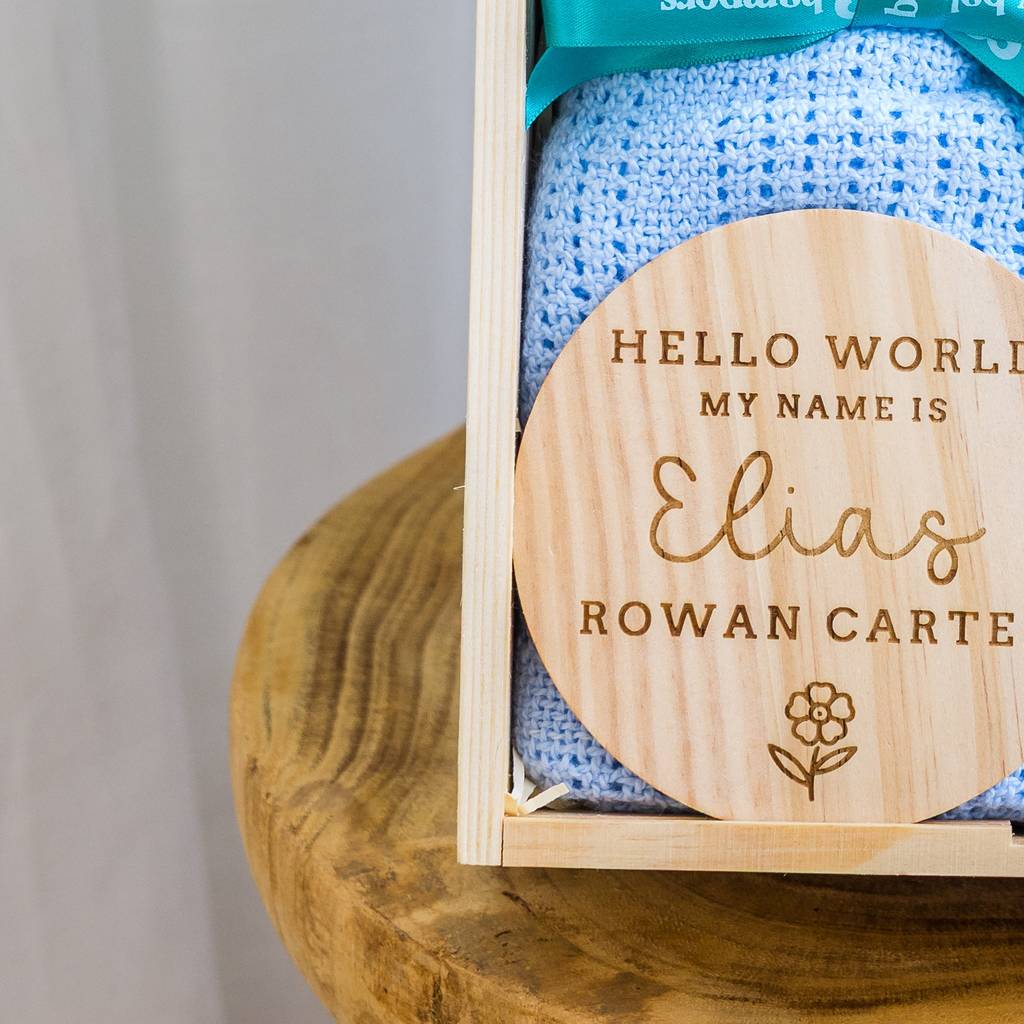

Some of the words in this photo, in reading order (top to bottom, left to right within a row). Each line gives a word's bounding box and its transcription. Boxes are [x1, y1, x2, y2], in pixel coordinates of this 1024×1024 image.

[610, 328, 800, 369] HELLO
[699, 391, 759, 418] MY
[776, 392, 894, 422] NAME
[911, 397, 948, 424] IS
[649, 449, 987, 586] Elias
[579, 599, 801, 641] ROWAN
